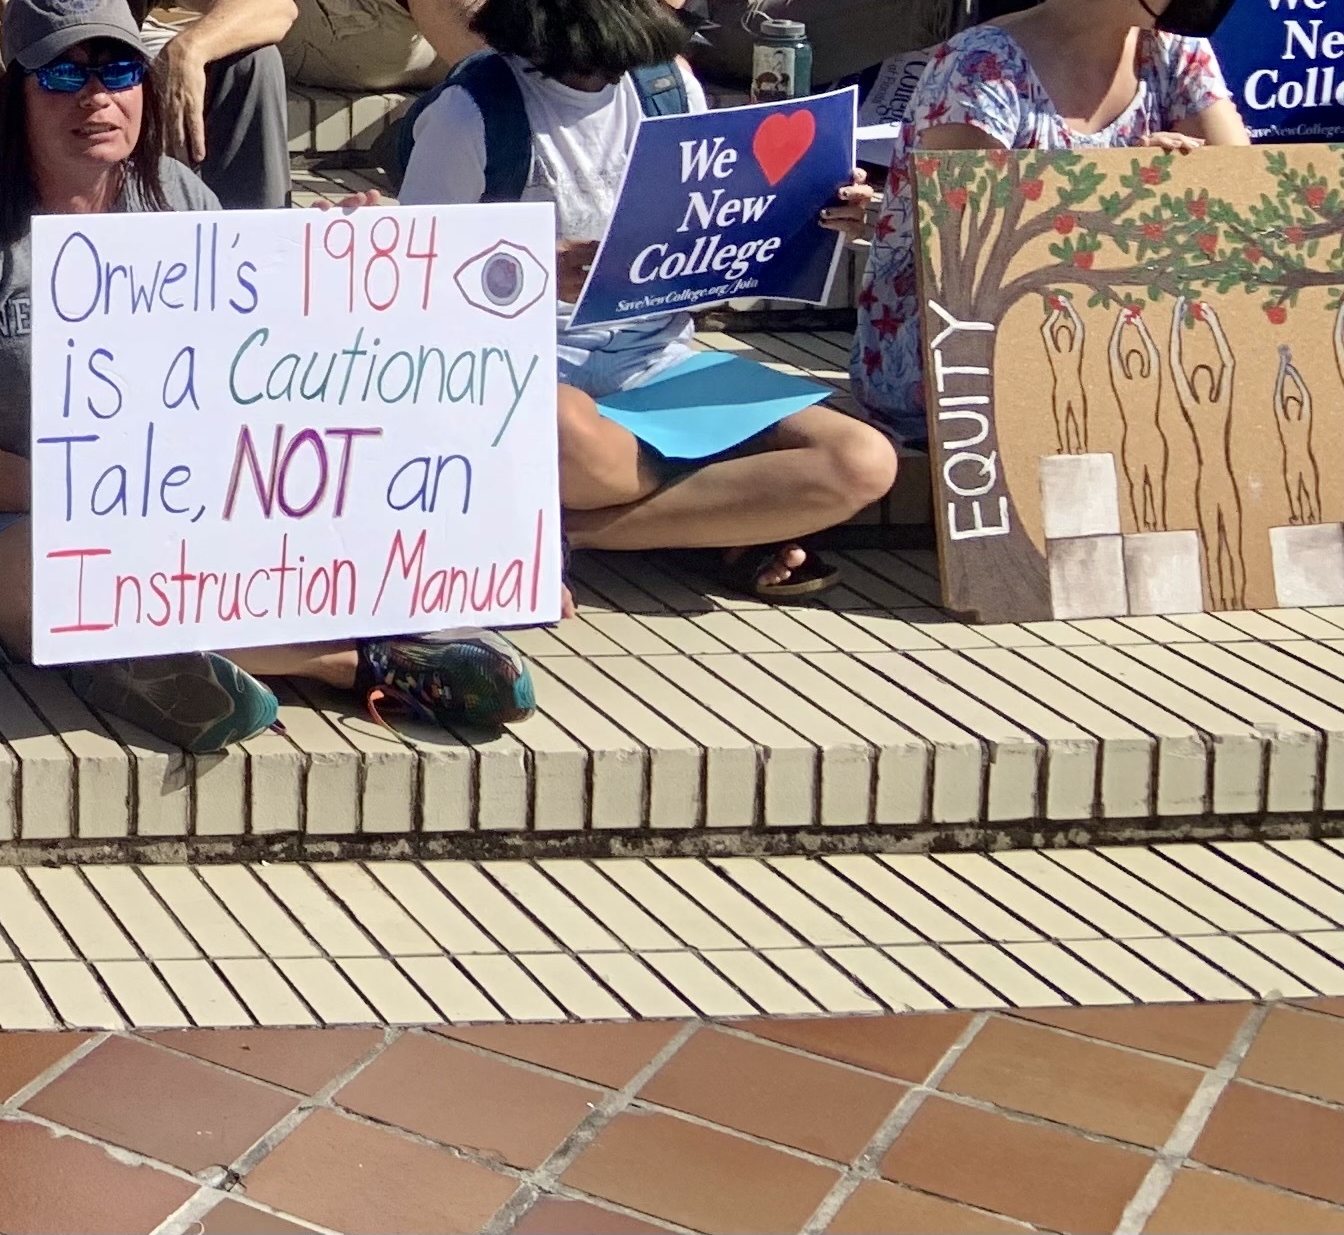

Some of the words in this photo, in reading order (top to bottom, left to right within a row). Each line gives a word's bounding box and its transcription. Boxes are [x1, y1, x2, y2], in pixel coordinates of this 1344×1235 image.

[680, 136, 738, 183] We
[629, 233, 782, 288] College
[676, 192, 775, 233] New
[49, 222, 260, 324] Orwell's
[301, 214, 439, 318] 1984
[616, 278, 760, 314] SaveNewCollege.org/Join
[62, 338, 123, 420] is
[162, 345, 199, 411] a
[228, 325, 540, 448] Cautionary
[928, 300, 1012, 542] EQUITY
[37, 421, 207, 523] Tale,
[221, 423, 383, 520] NOT
[385, 451, 473, 516] an
[46, 532, 358, 633] Instruction
[372, 509, 545, 619] Manual
